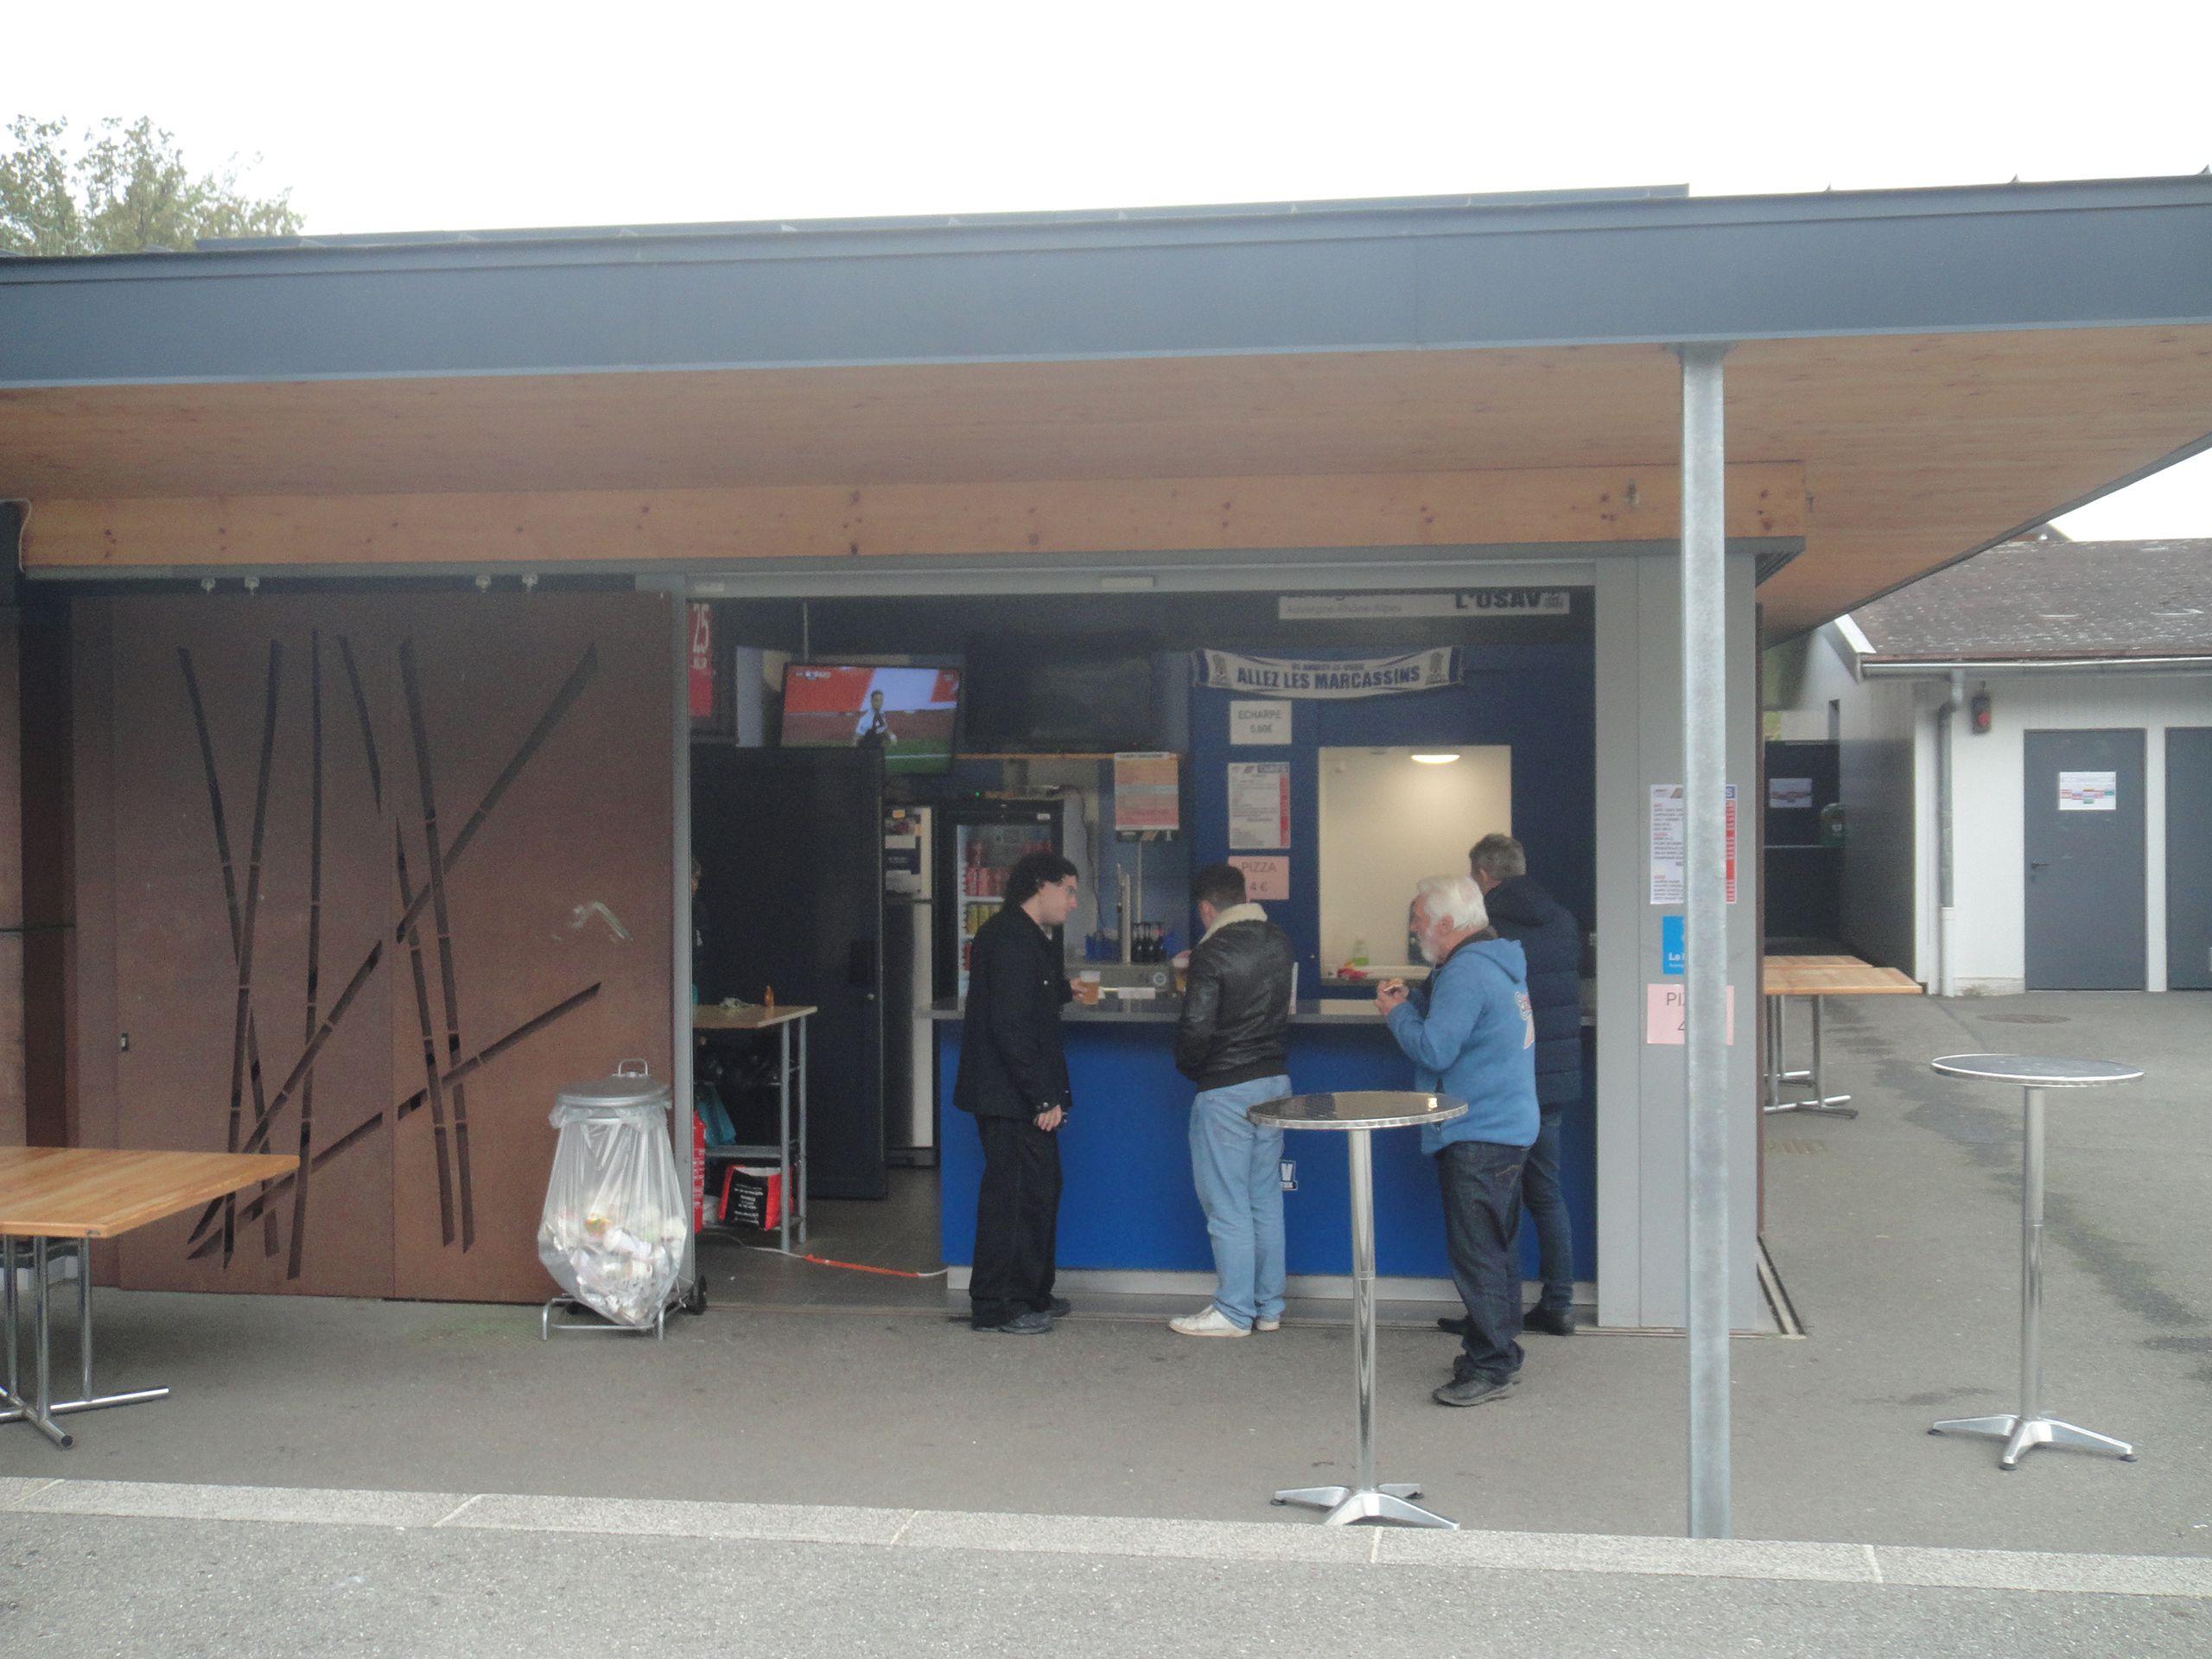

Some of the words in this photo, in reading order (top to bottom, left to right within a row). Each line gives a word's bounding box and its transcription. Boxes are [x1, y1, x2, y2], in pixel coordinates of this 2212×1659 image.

[1236, 667, 1280, 687] ALLEZ
[1284, 674, 1311, 689] LES
[1314, 664, 1421, 690] MARCASSINS
[1238, 709, 1282, 720] ECHARPE
[1241, 861, 1277, 873] PIZZA
